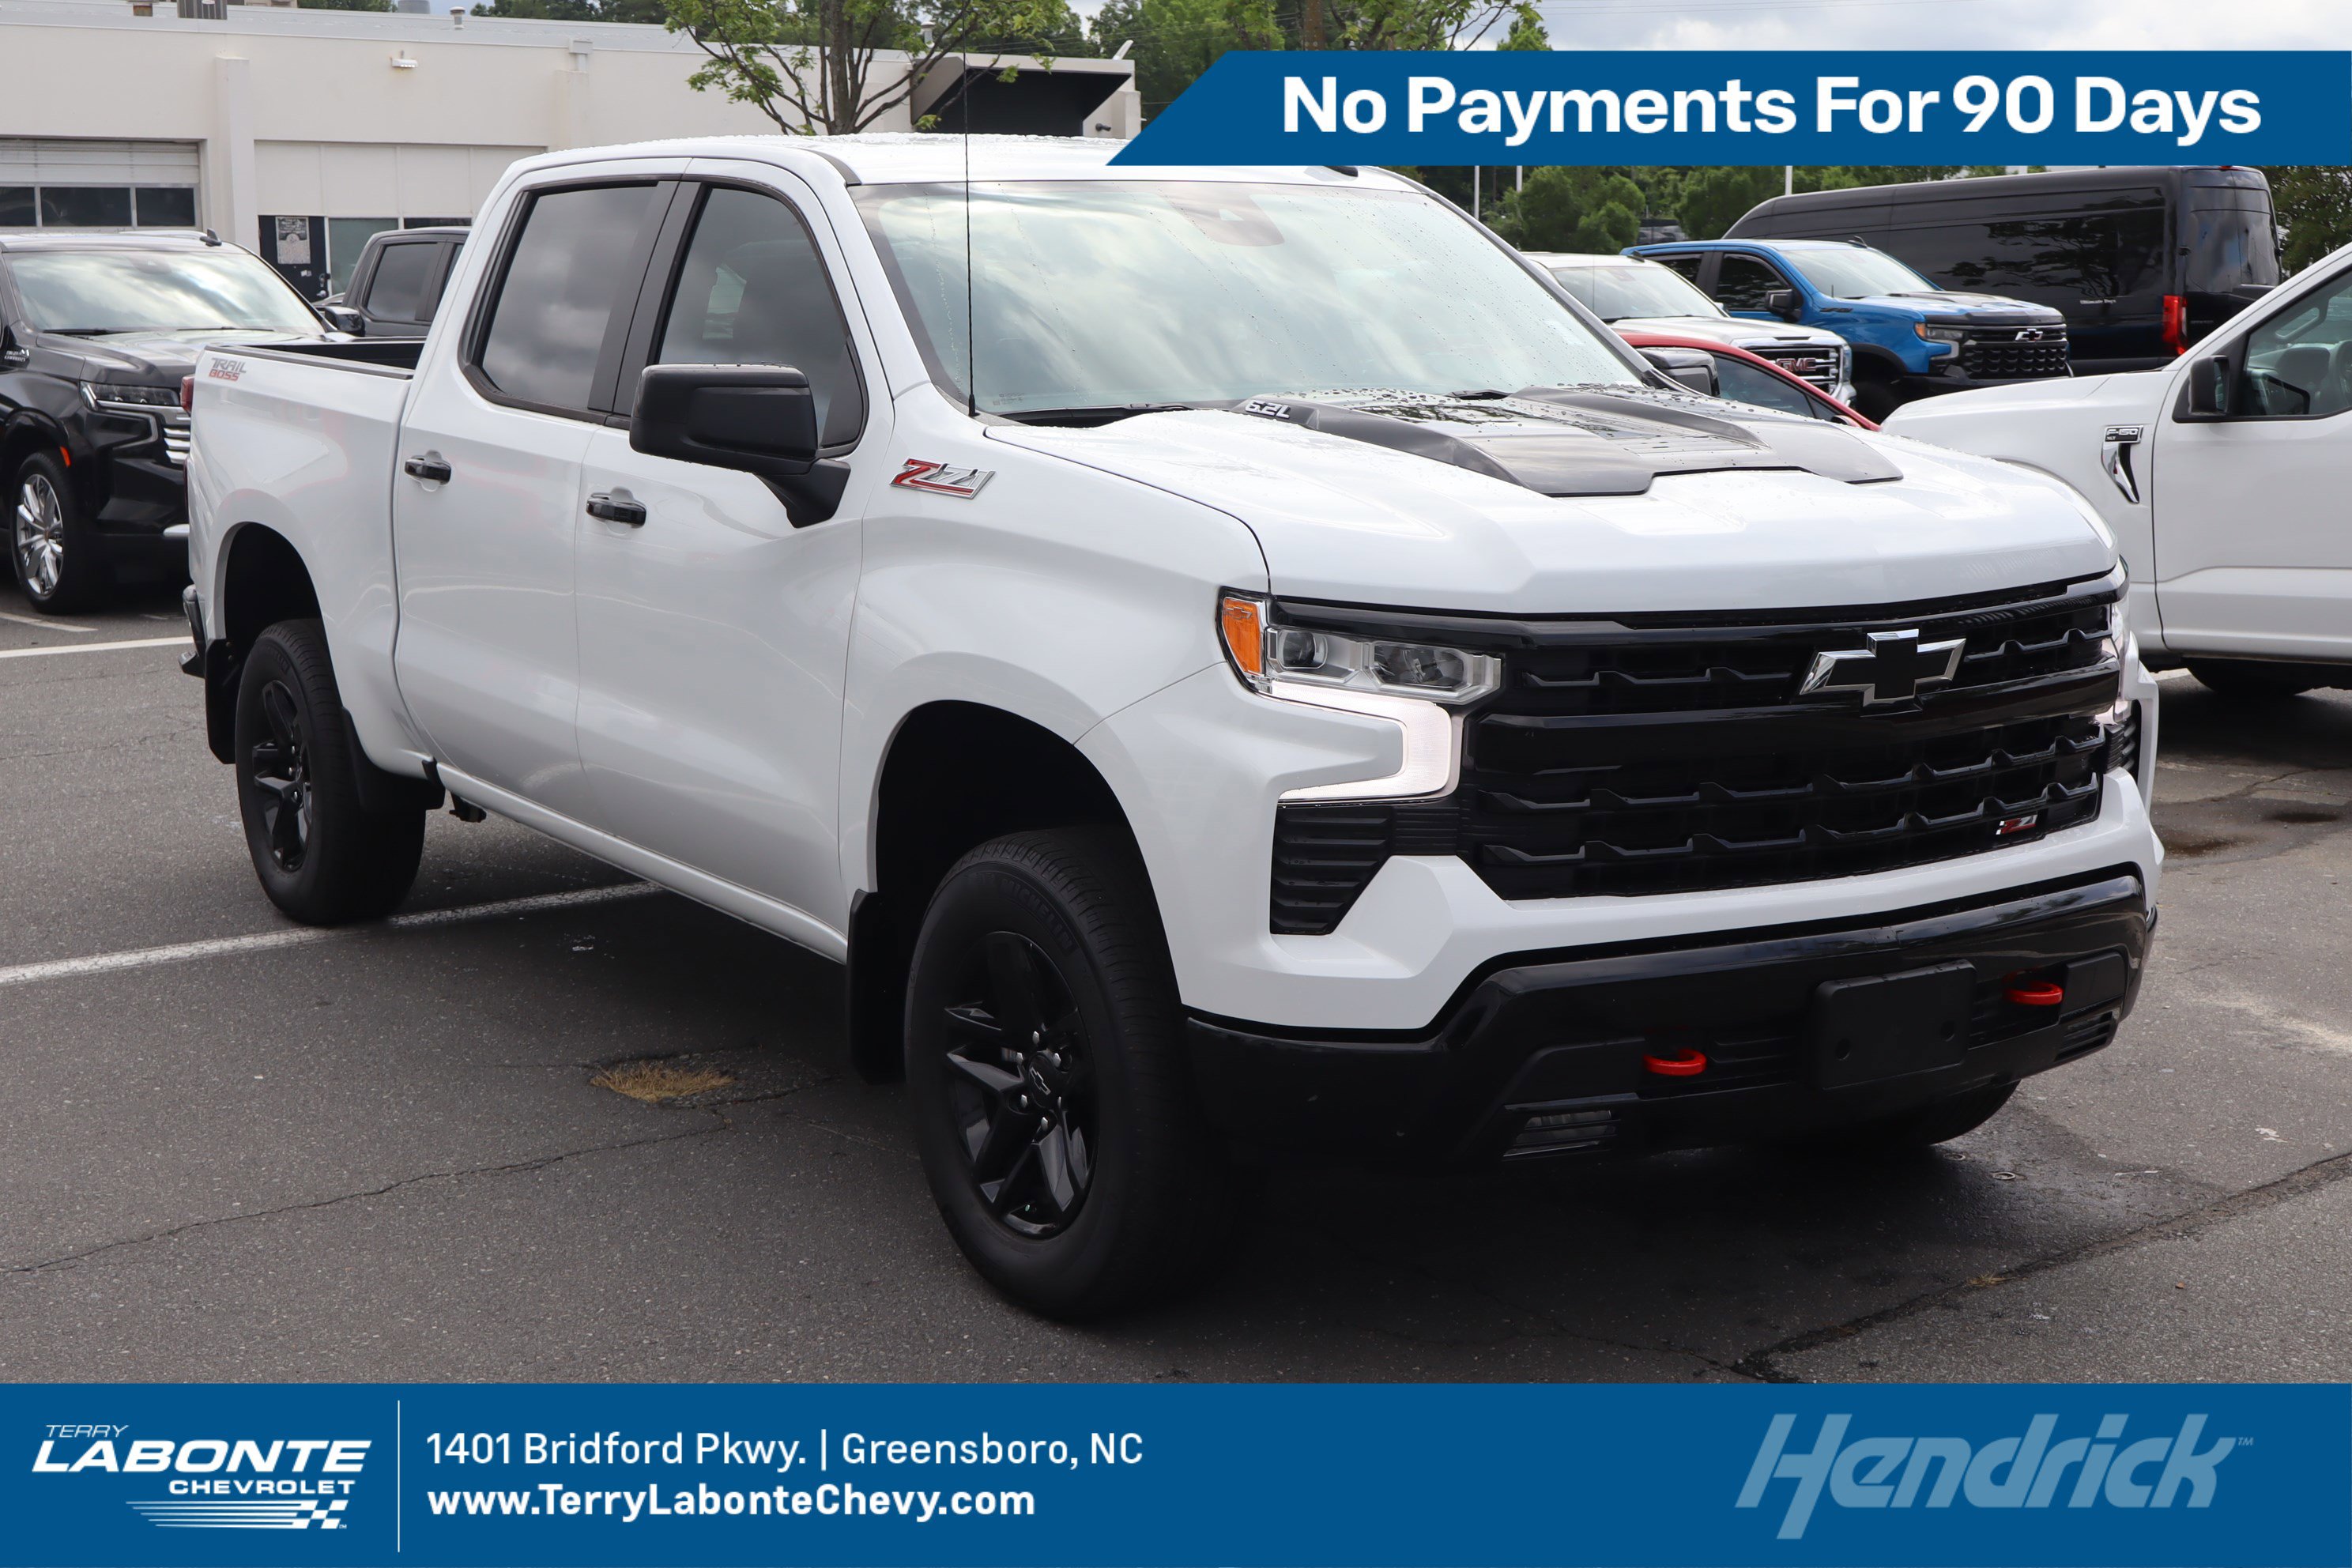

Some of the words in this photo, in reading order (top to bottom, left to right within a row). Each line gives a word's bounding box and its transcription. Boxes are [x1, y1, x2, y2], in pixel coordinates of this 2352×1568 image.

[211, 357, 247, 373] TRAIL
[1776, 357, 1816, 372] GMC
[209, 368, 240, 382] BOSS
[889, 457, 997, 500] Z71
